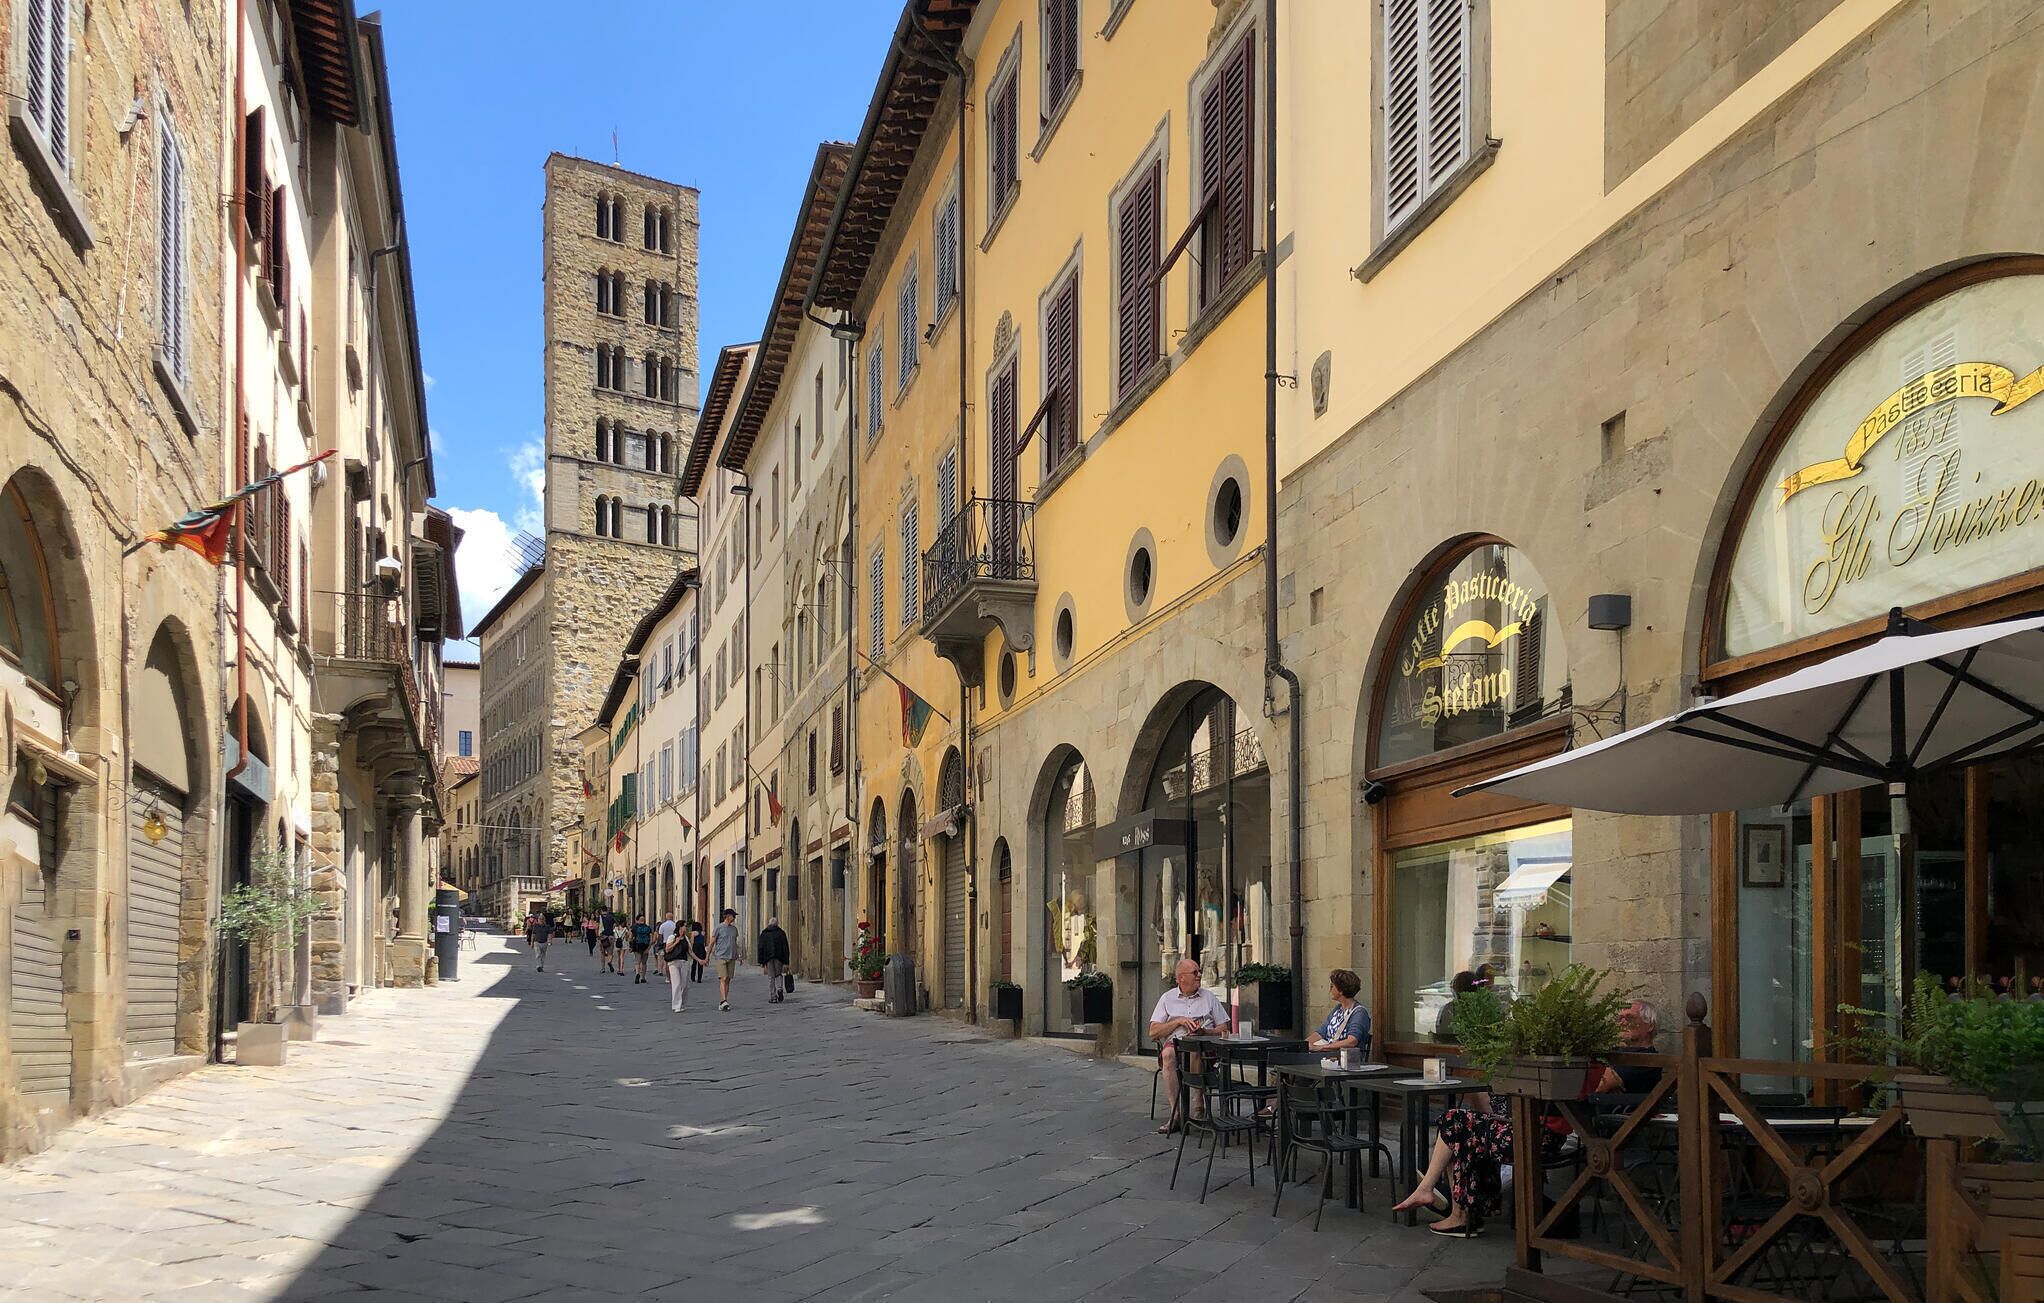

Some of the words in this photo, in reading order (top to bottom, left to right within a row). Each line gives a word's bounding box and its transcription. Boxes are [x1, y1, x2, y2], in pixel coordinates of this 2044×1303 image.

[1861, 367, 1993, 450] Pasticceria
[1894, 403, 1956, 462] 1857
[1802, 485, 1881, 615] Gli
[1442, 567, 1538, 627] Pasticceria
[1420, 667, 1512, 729] Stefano
